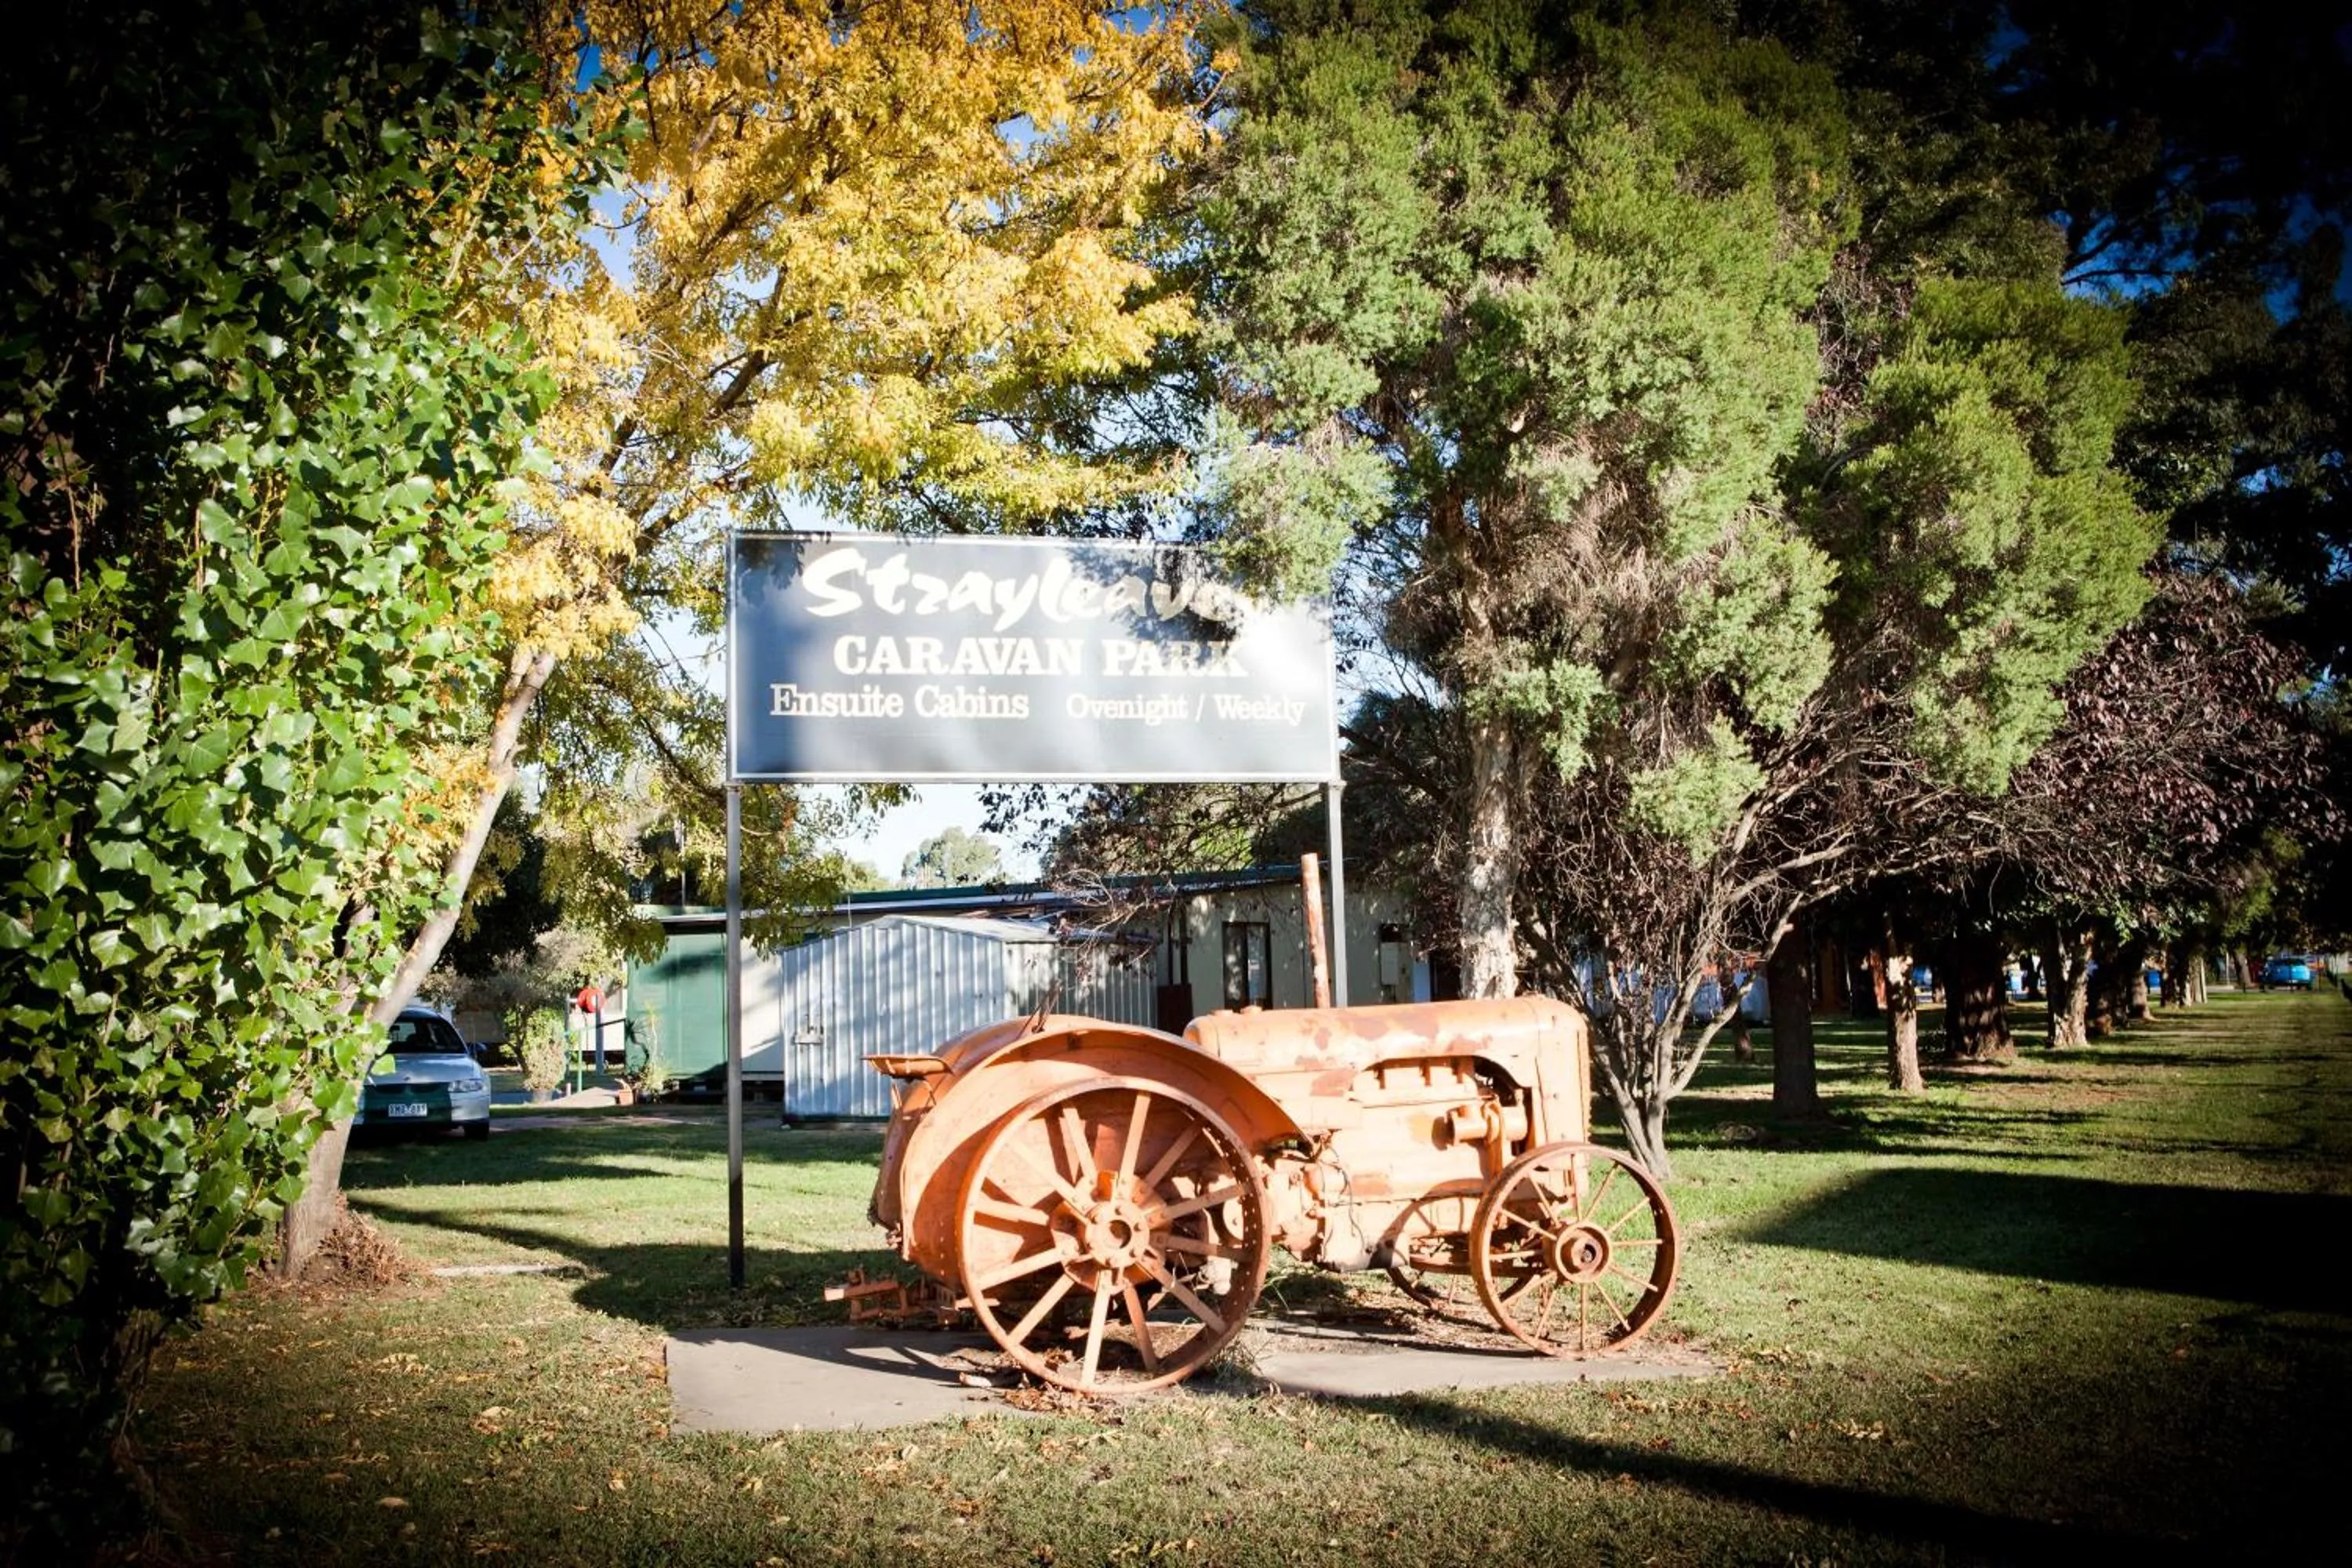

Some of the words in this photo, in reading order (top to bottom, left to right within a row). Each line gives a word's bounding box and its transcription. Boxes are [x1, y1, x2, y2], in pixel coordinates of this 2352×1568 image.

[833, 634, 1085, 676] CARAVAN
[1101, 638, 1250, 677] PARK
[770, 683, 904, 718] Ensuite
[914, 684, 1029, 719] Cabins
[1065, 693, 1189, 727] Ovenight
[1212, 693, 1306, 727] Weekly
